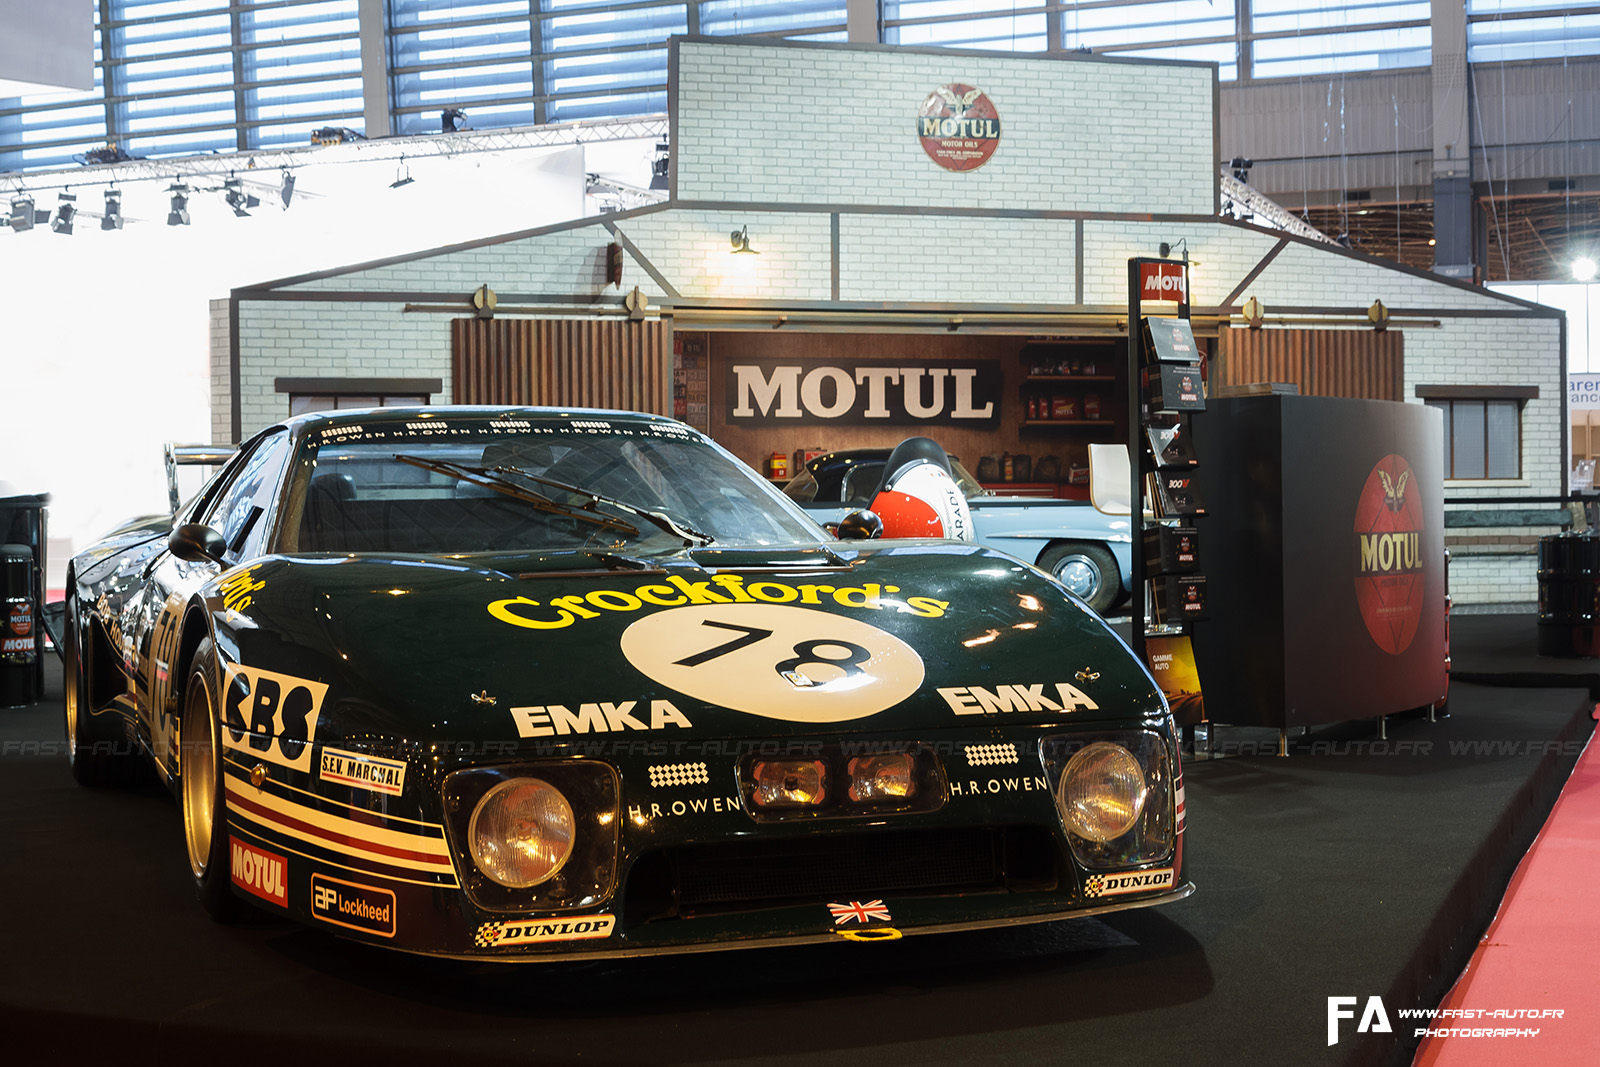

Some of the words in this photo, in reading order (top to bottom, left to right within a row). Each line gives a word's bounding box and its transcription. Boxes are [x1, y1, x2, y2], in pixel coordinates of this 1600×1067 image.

[923, 117, 998, 138] MOTUL
[964, 141, 979, 149] OILS
[732, 365, 994, 419] MOTUL
[1169, 479, 1190, 488] 300V
[1361, 533, 1422, 572] MOTUL
[487, 574, 949, 630] Crockford's
[10, 615, 31, 623] MOTUL
[671, 619, 872, 691] 78
[1153, 654, 1173, 662] GAMME
[1155, 662, 1170, 670] AUTO
[936, 682, 1099, 716] EMKA
[510, 700, 693, 739] EMKA
[322, 756, 343, 775] S.E.V.
[347, 761, 401, 786] MARCHAL
[950, 776, 1047, 796] H.R.OWEN
[628, 796, 740, 820] H.R.OWEN
[232, 843, 285, 899] MOTUL
[1106, 873, 1171, 890] DUNLOP
[338, 893, 390, 923] Lockheed
[503, 920, 610, 939] DUNLOP
